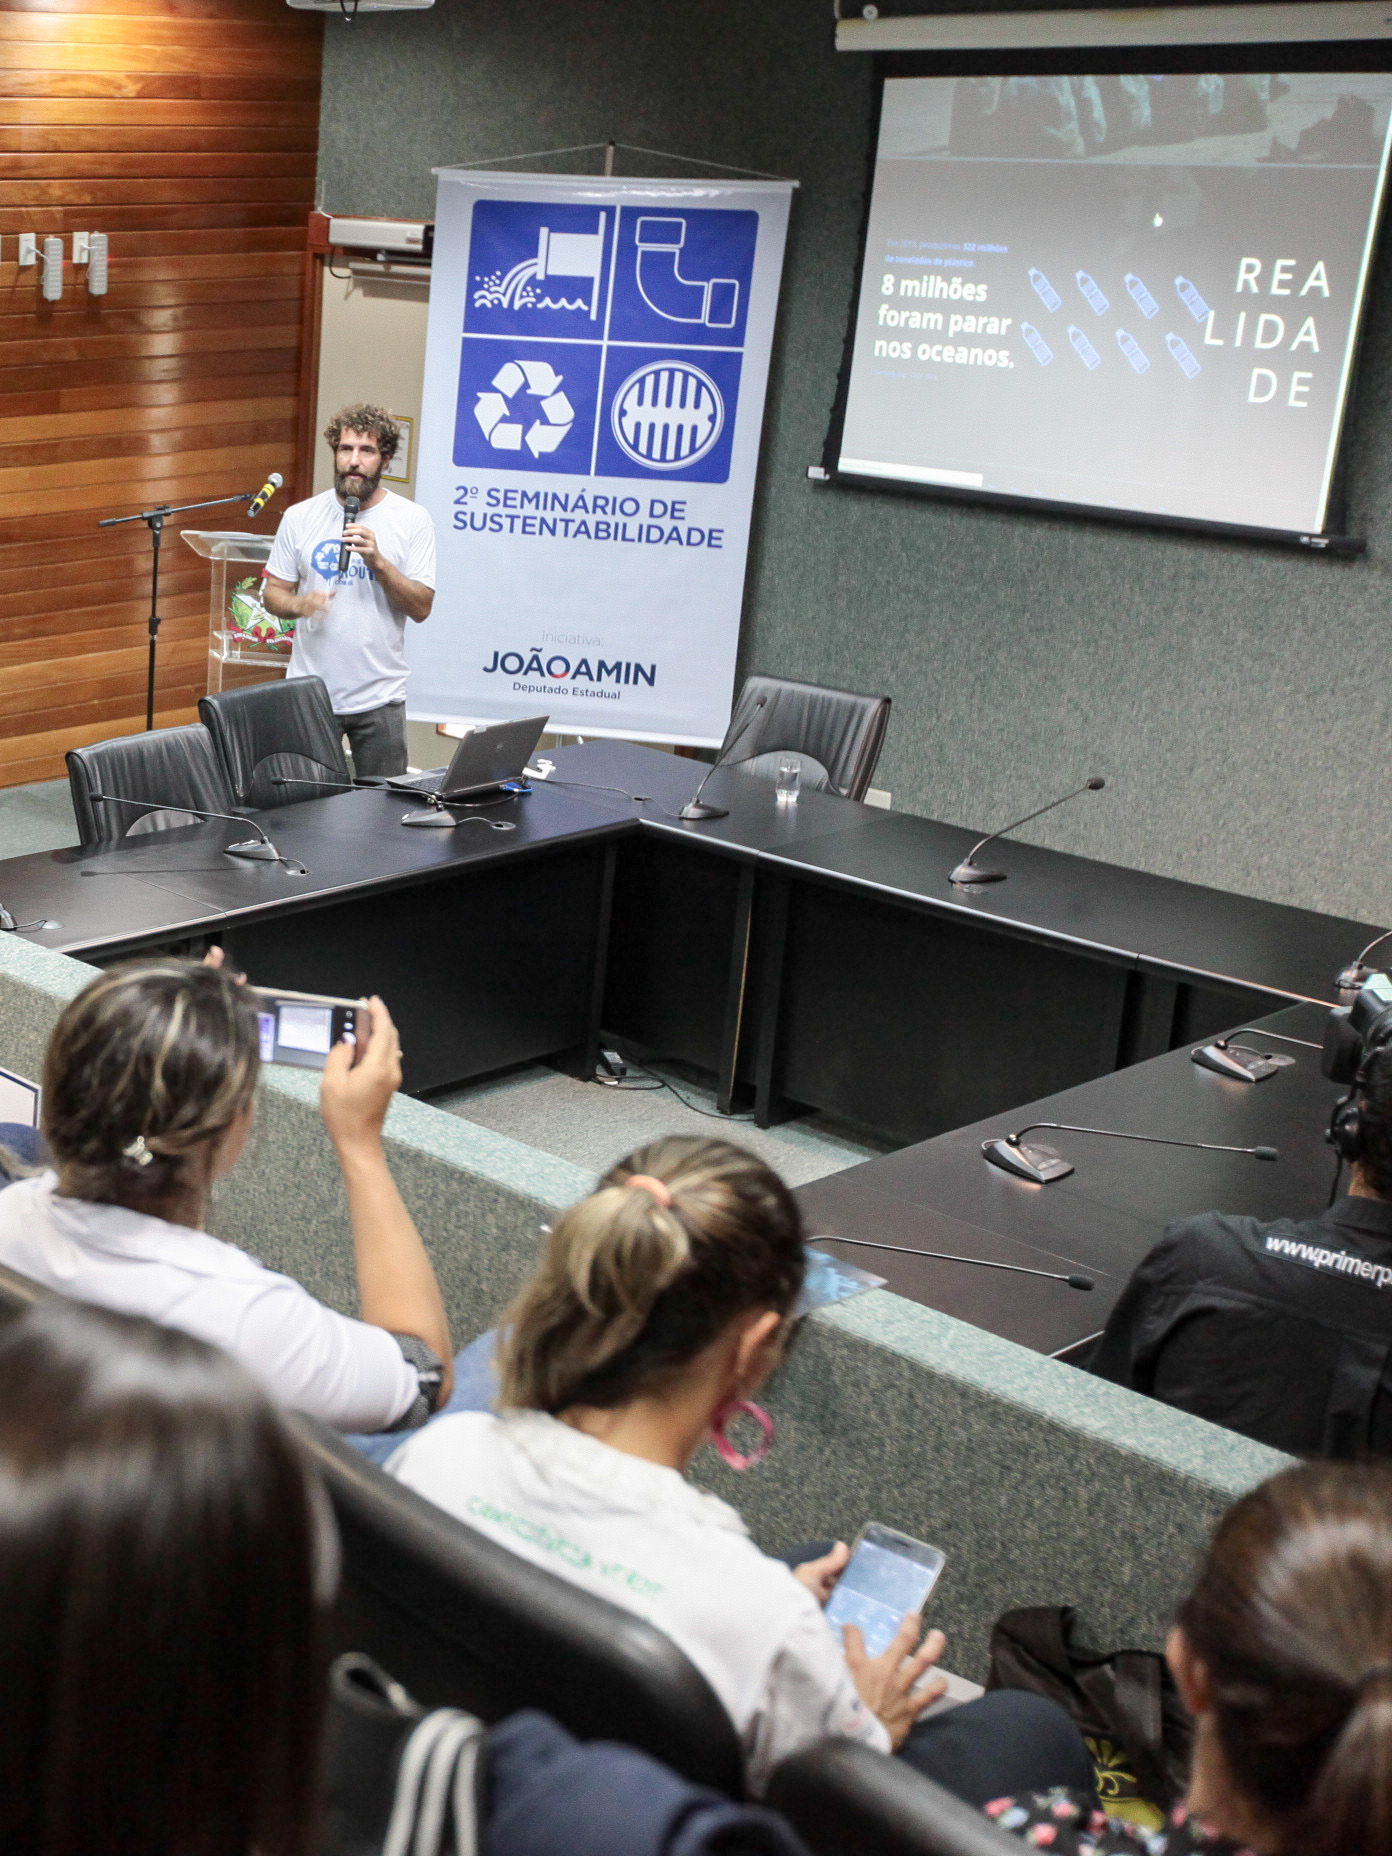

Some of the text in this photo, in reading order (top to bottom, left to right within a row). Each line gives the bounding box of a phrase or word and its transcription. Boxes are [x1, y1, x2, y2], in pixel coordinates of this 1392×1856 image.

[881, 273, 988, 302] 8 milhões
[1234, 256, 1331, 299] REA
[878, 304, 1012, 338] foram parar
[1203, 309, 1321, 354] LIDA
[873, 337, 1015, 369] nos oceanos.
[1247, 367, 1314, 408] DE
[452, 485, 687, 521] 2º SEMINÁRIO DE
[452, 510, 725, 549] SUSTENTABILIDADE
[541, 629, 604, 648] Iniciativa:
[512, 681, 621, 701] Deputado Estadual
